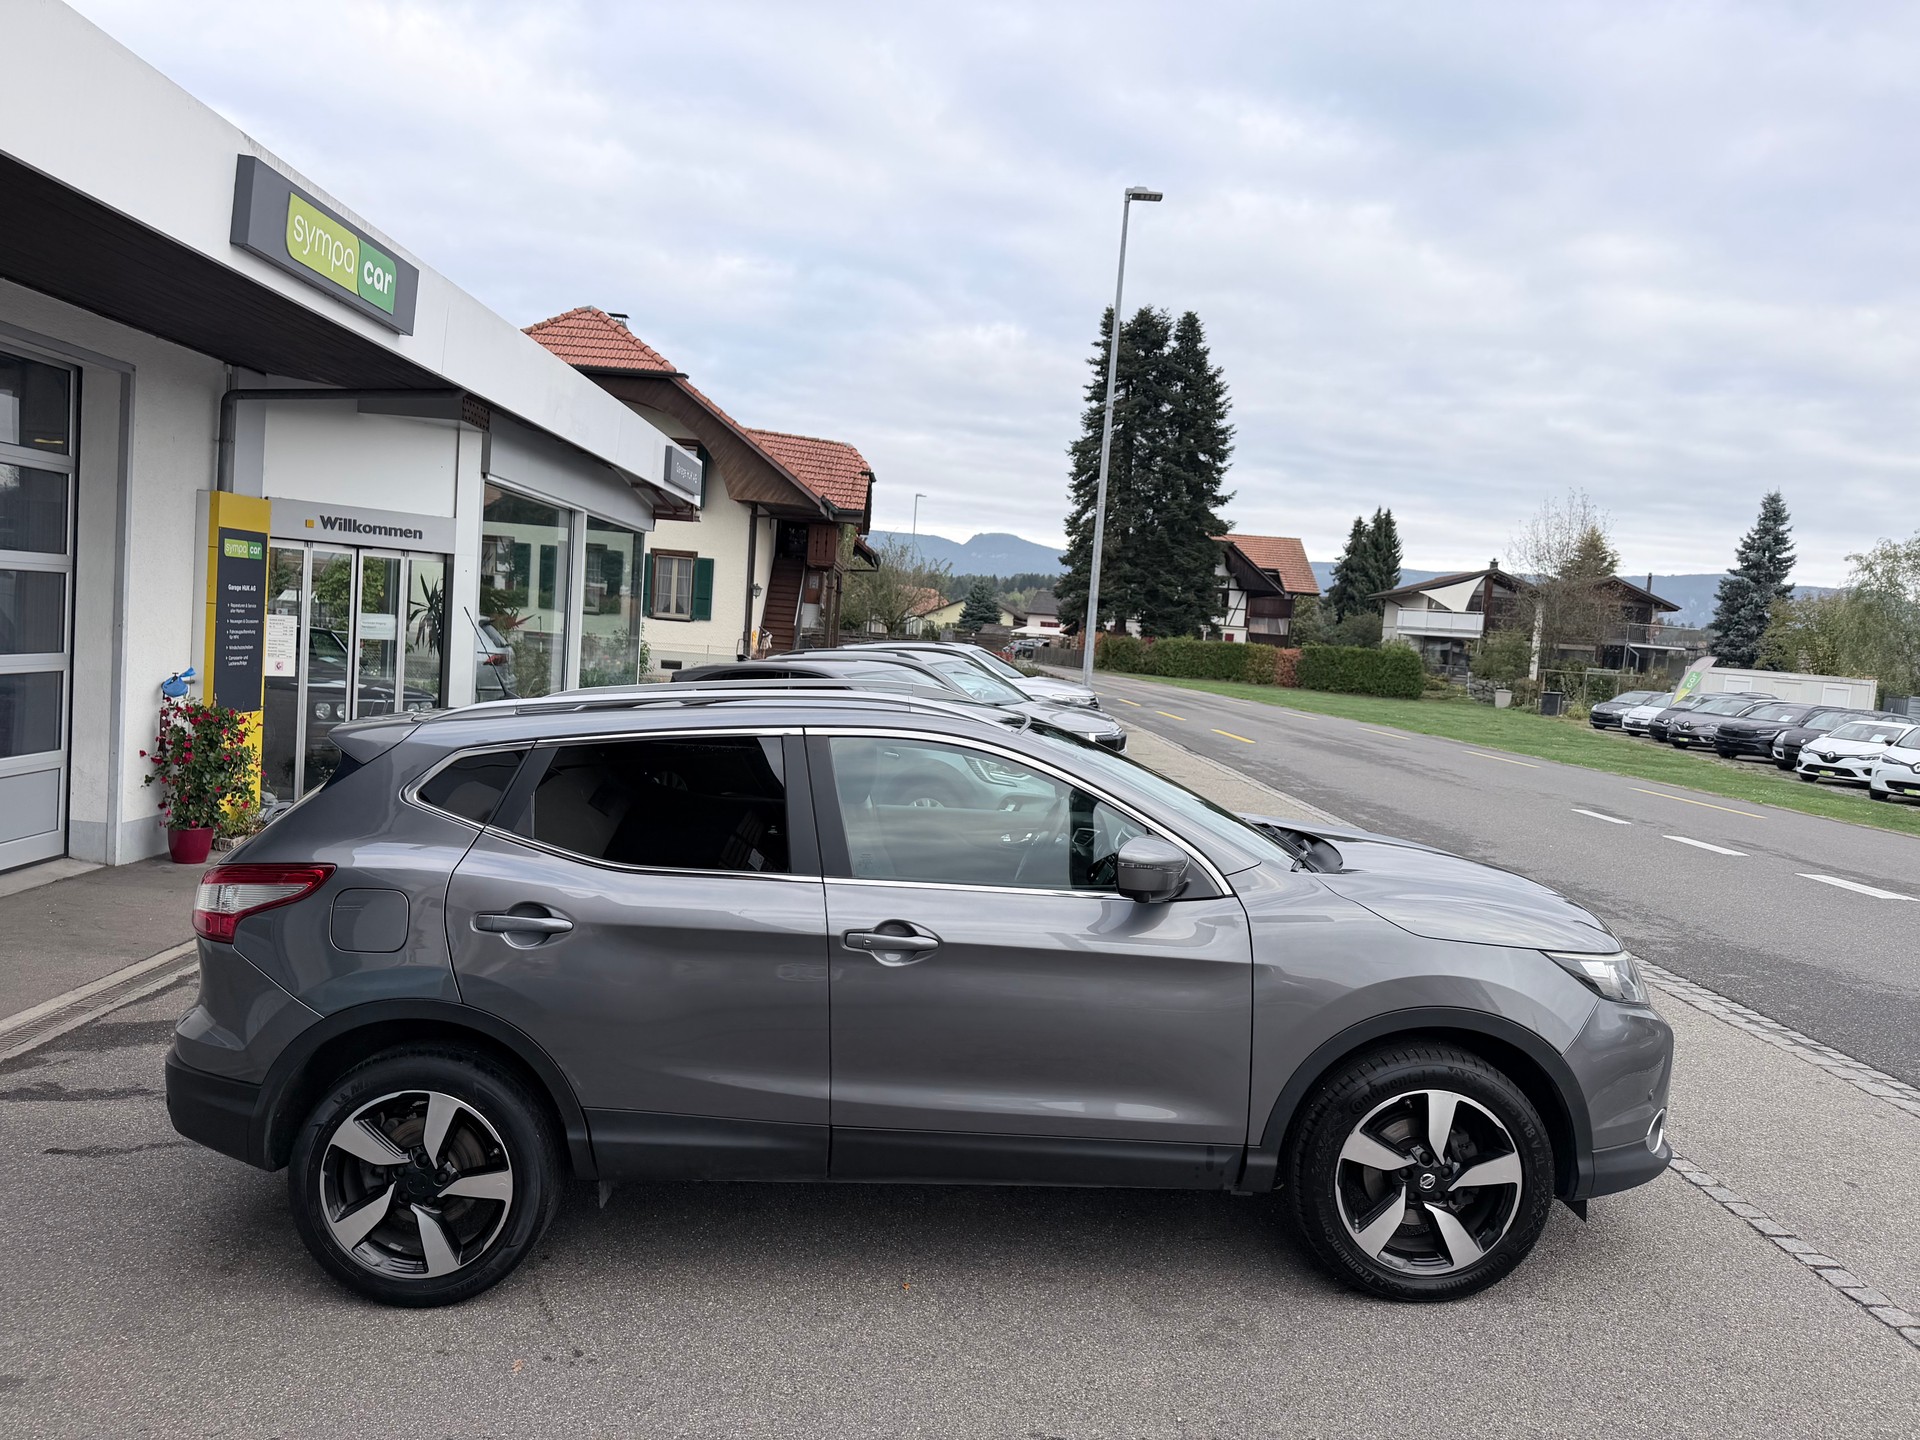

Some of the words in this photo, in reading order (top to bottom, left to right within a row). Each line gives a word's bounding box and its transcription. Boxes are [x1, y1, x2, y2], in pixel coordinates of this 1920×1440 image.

[293, 214, 355, 274] sympa
[363, 260, 393, 295] car
[320, 515, 423, 539] Willkommen
[225, 542, 247, 554] sympa
[249, 545, 261, 555] car
[228, 584, 241, 592] Garage
[1687, 673, 1697, 688] car
[1350, 1069, 1426, 1114] Continental
